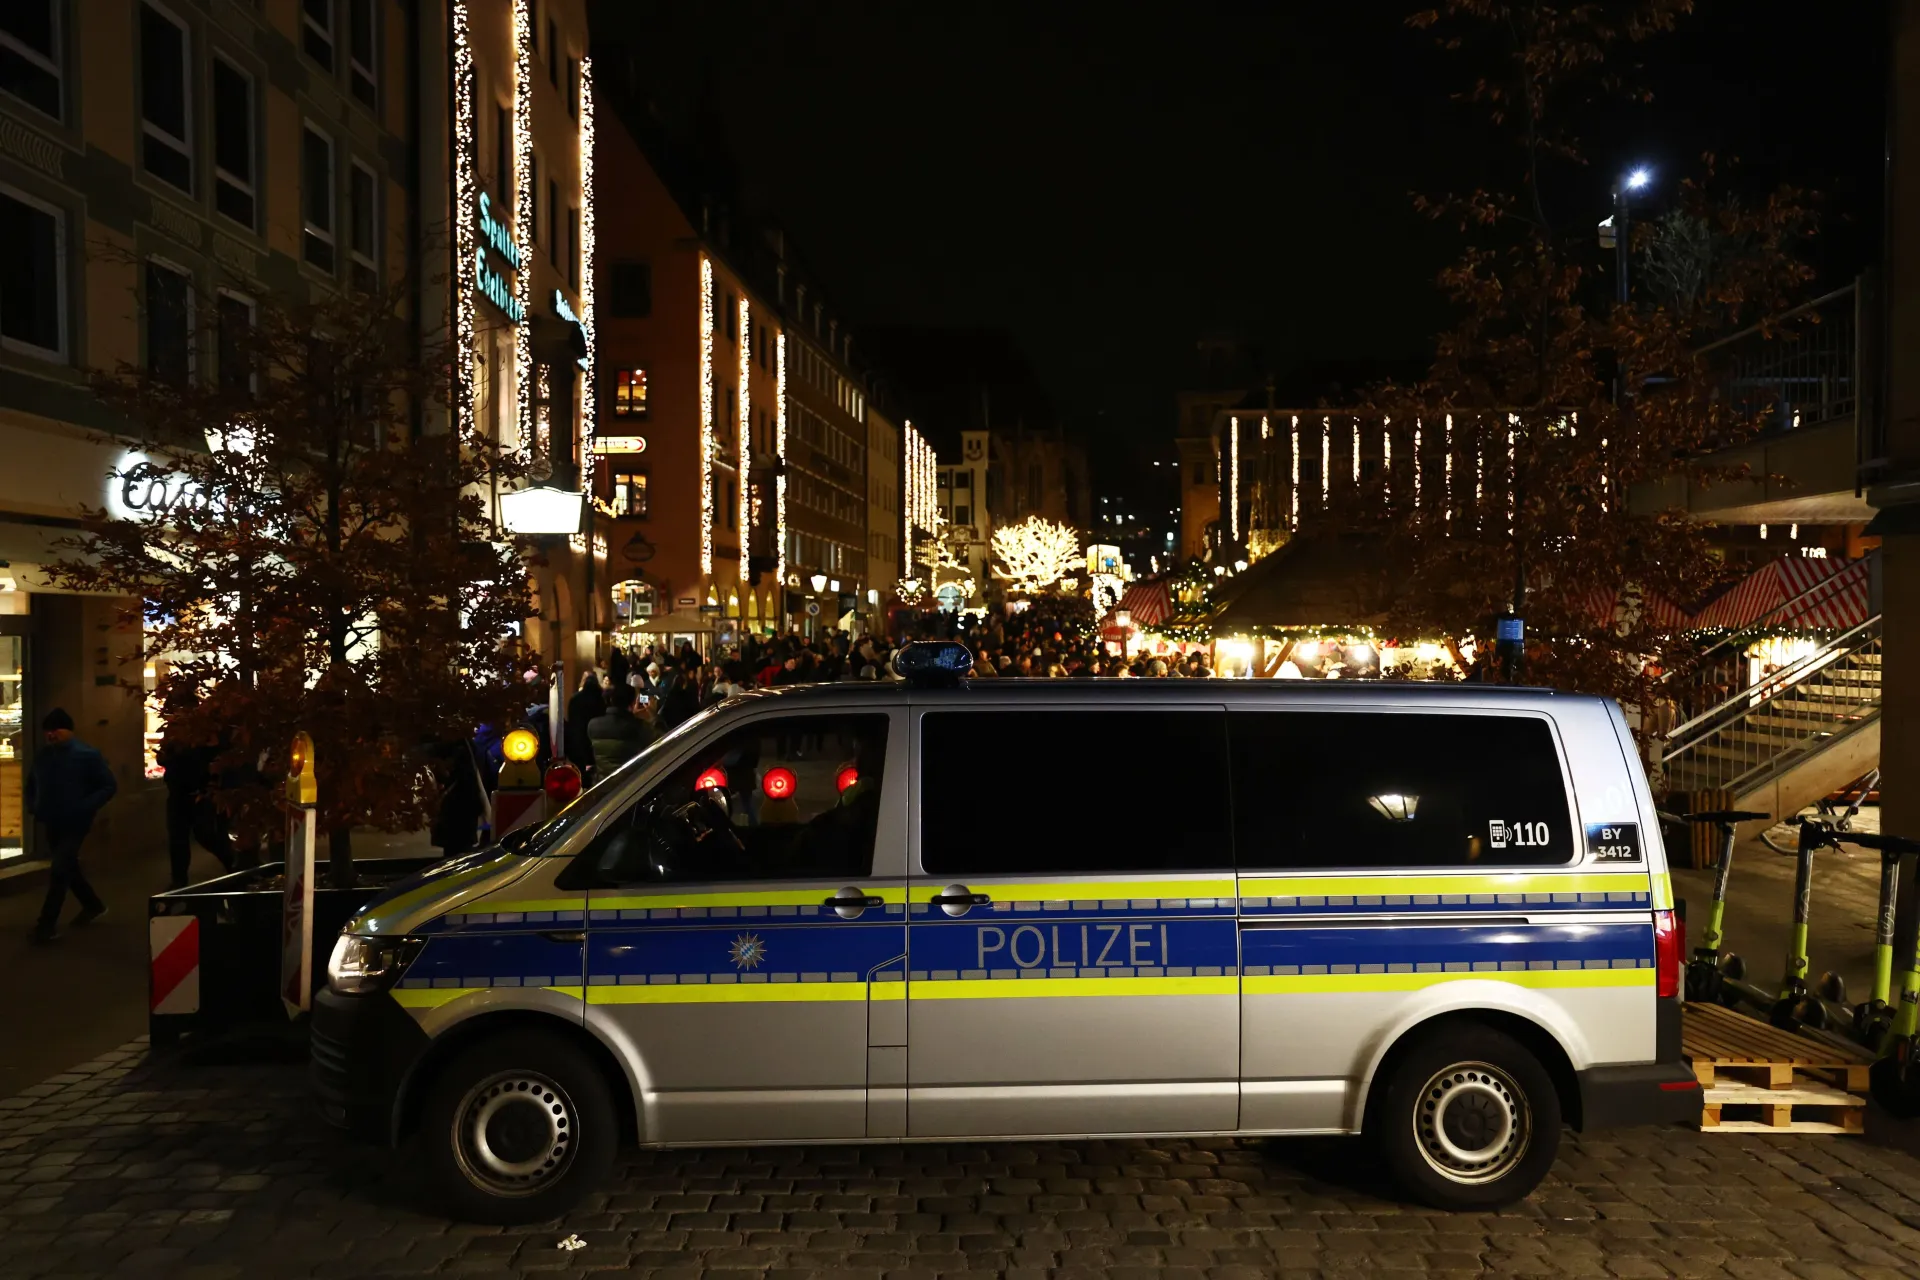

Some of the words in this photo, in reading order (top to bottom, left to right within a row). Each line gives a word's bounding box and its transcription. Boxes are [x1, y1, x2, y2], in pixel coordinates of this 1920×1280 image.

[1513, 821, 1550, 847] 110
[1602, 828, 1622, 840] BY
[1598, 846, 1632, 858] 3412
[977, 924, 1169, 969] POLIZEI
